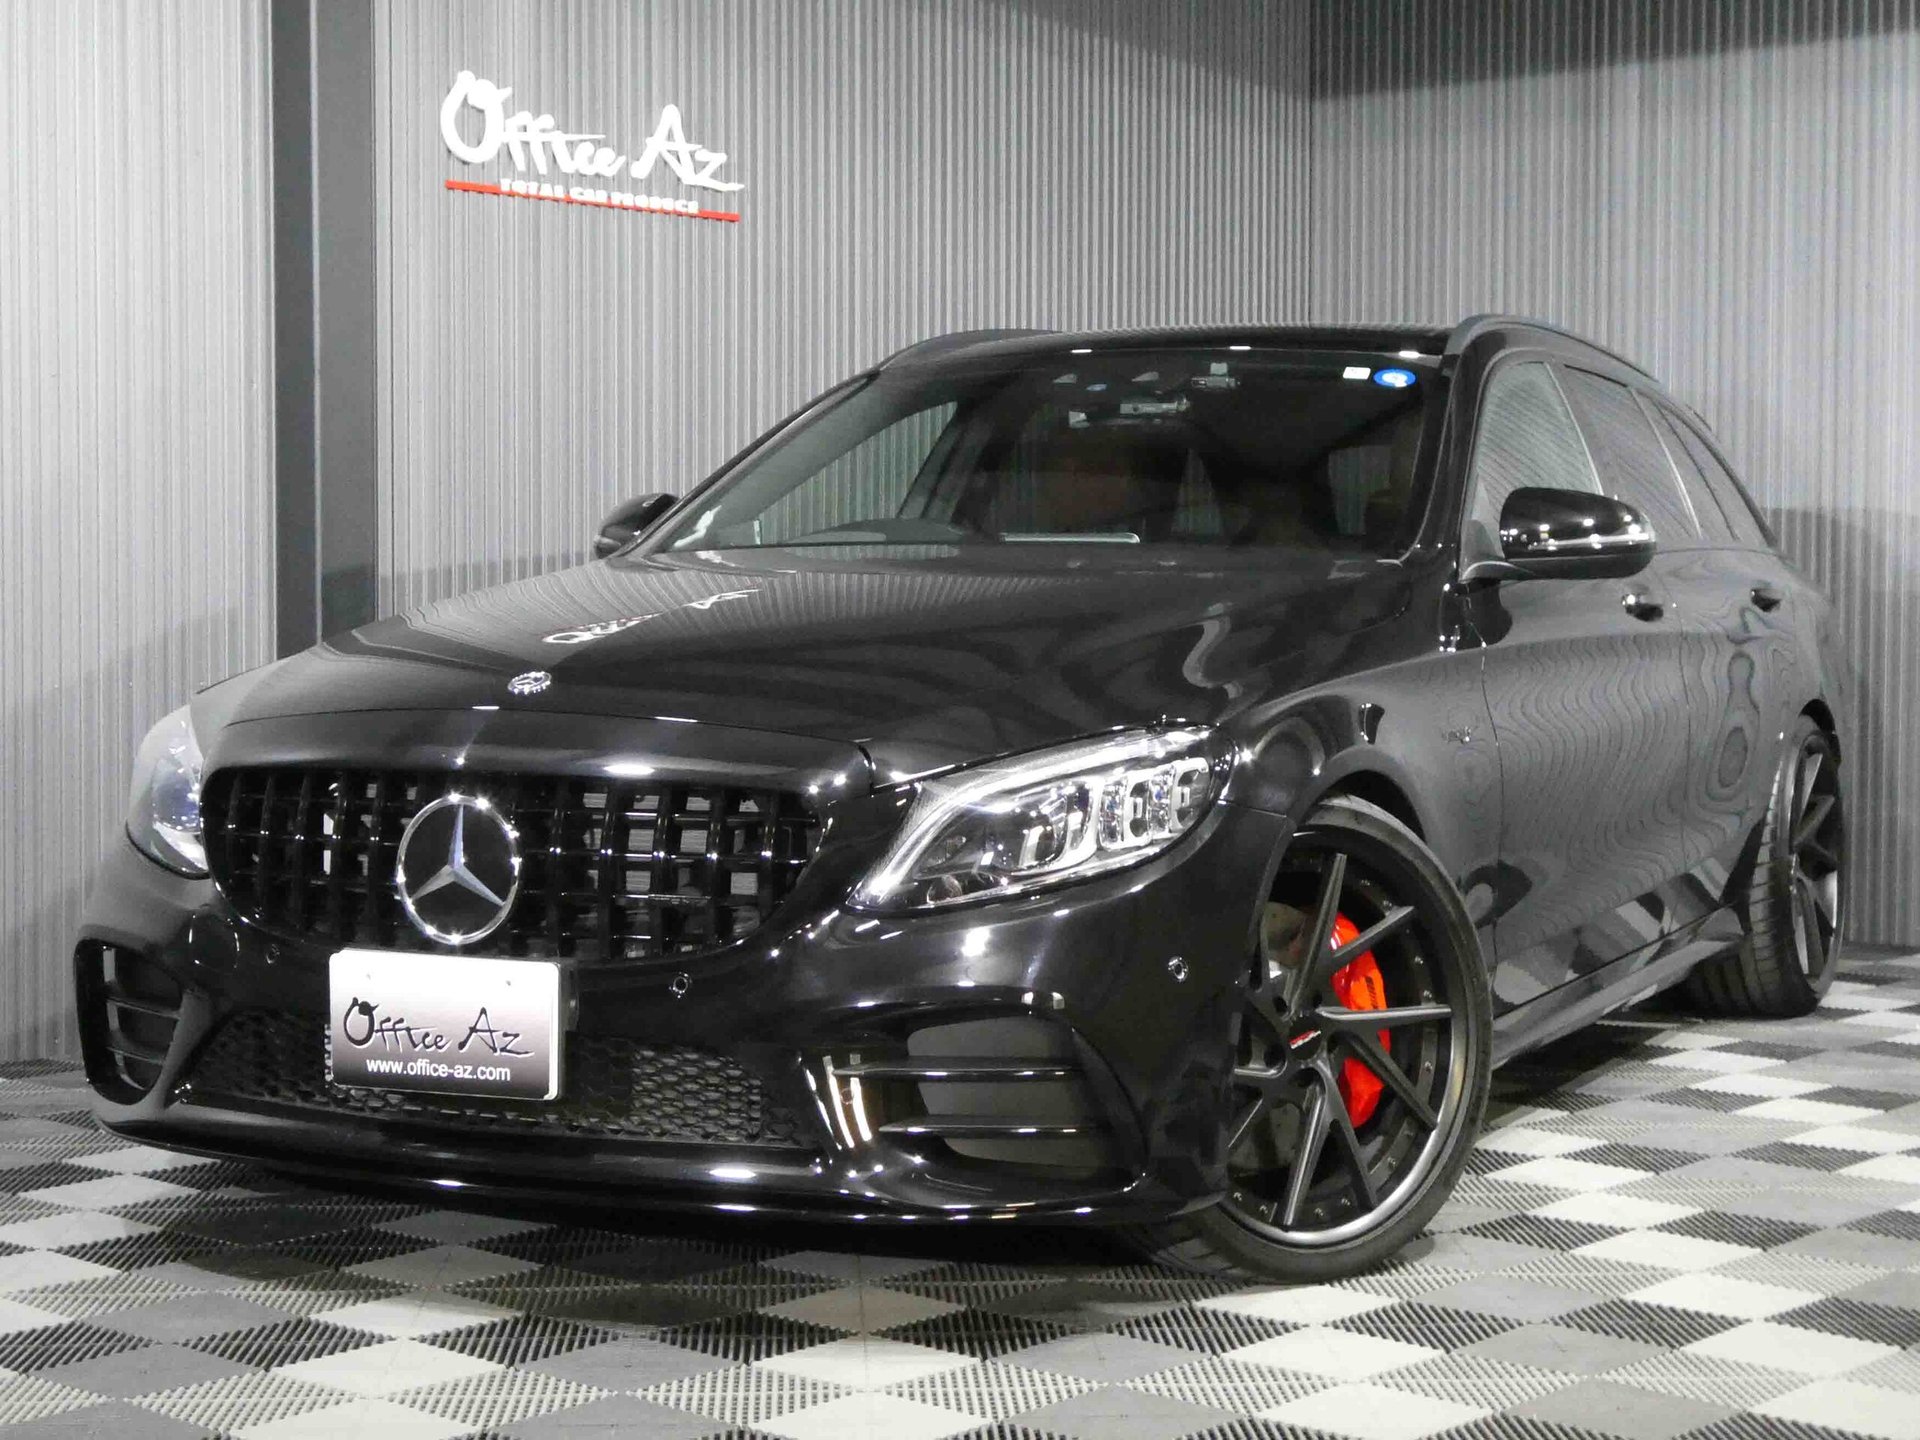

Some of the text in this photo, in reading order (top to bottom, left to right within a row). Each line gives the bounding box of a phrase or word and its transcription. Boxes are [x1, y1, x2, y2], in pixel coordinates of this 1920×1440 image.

[441, 70, 745, 192] Office Az
[343, 997, 534, 1056] Office Az
[366, 1059, 511, 1082] www.office-az.com
